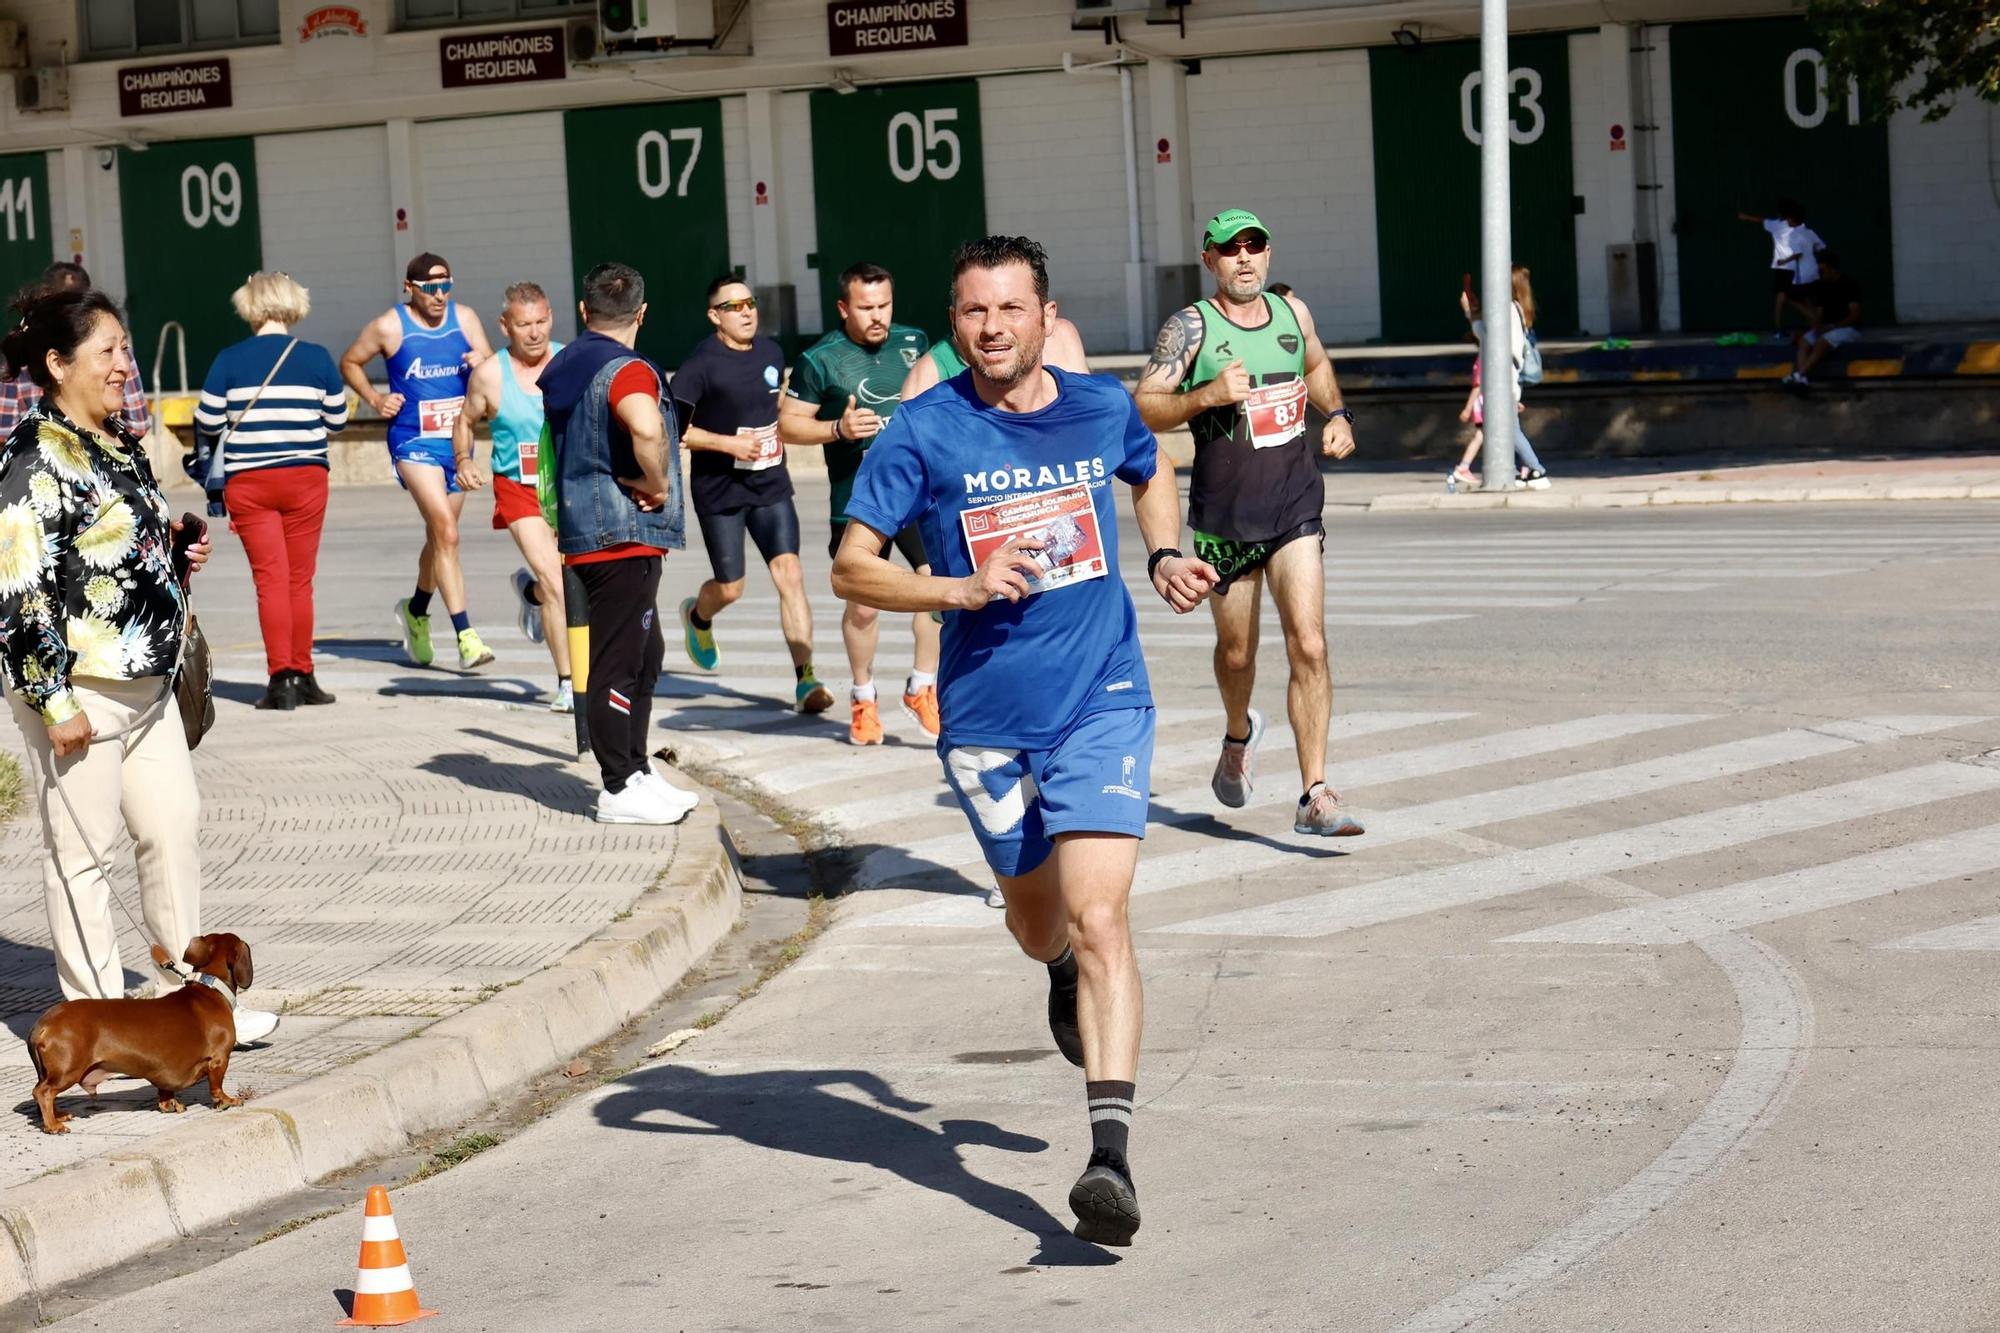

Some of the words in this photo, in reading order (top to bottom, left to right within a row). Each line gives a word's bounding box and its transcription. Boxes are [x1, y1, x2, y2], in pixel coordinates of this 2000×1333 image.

[835, 0, 956, 27] CHAMPIÑONES
[446, 35, 554, 61] CHAMPIÑONES
[855, 24, 937, 47] REQUENA
[123, 66, 221, 91] CHAMPIÑONES
[464, 58, 537, 80] REQUENA
[140, 88, 206, 109] REQUENA
[887, 108, 961, 183] 05
[637, 127, 703, 199] 07
[181, 162, 242, 229] 09
[0, 176, 35, 242] 11
[1274, 401, 1298, 426] 83
[963, 457, 1105, 493] MORALES
[967, 493, 1003, 504] SERVICIO
